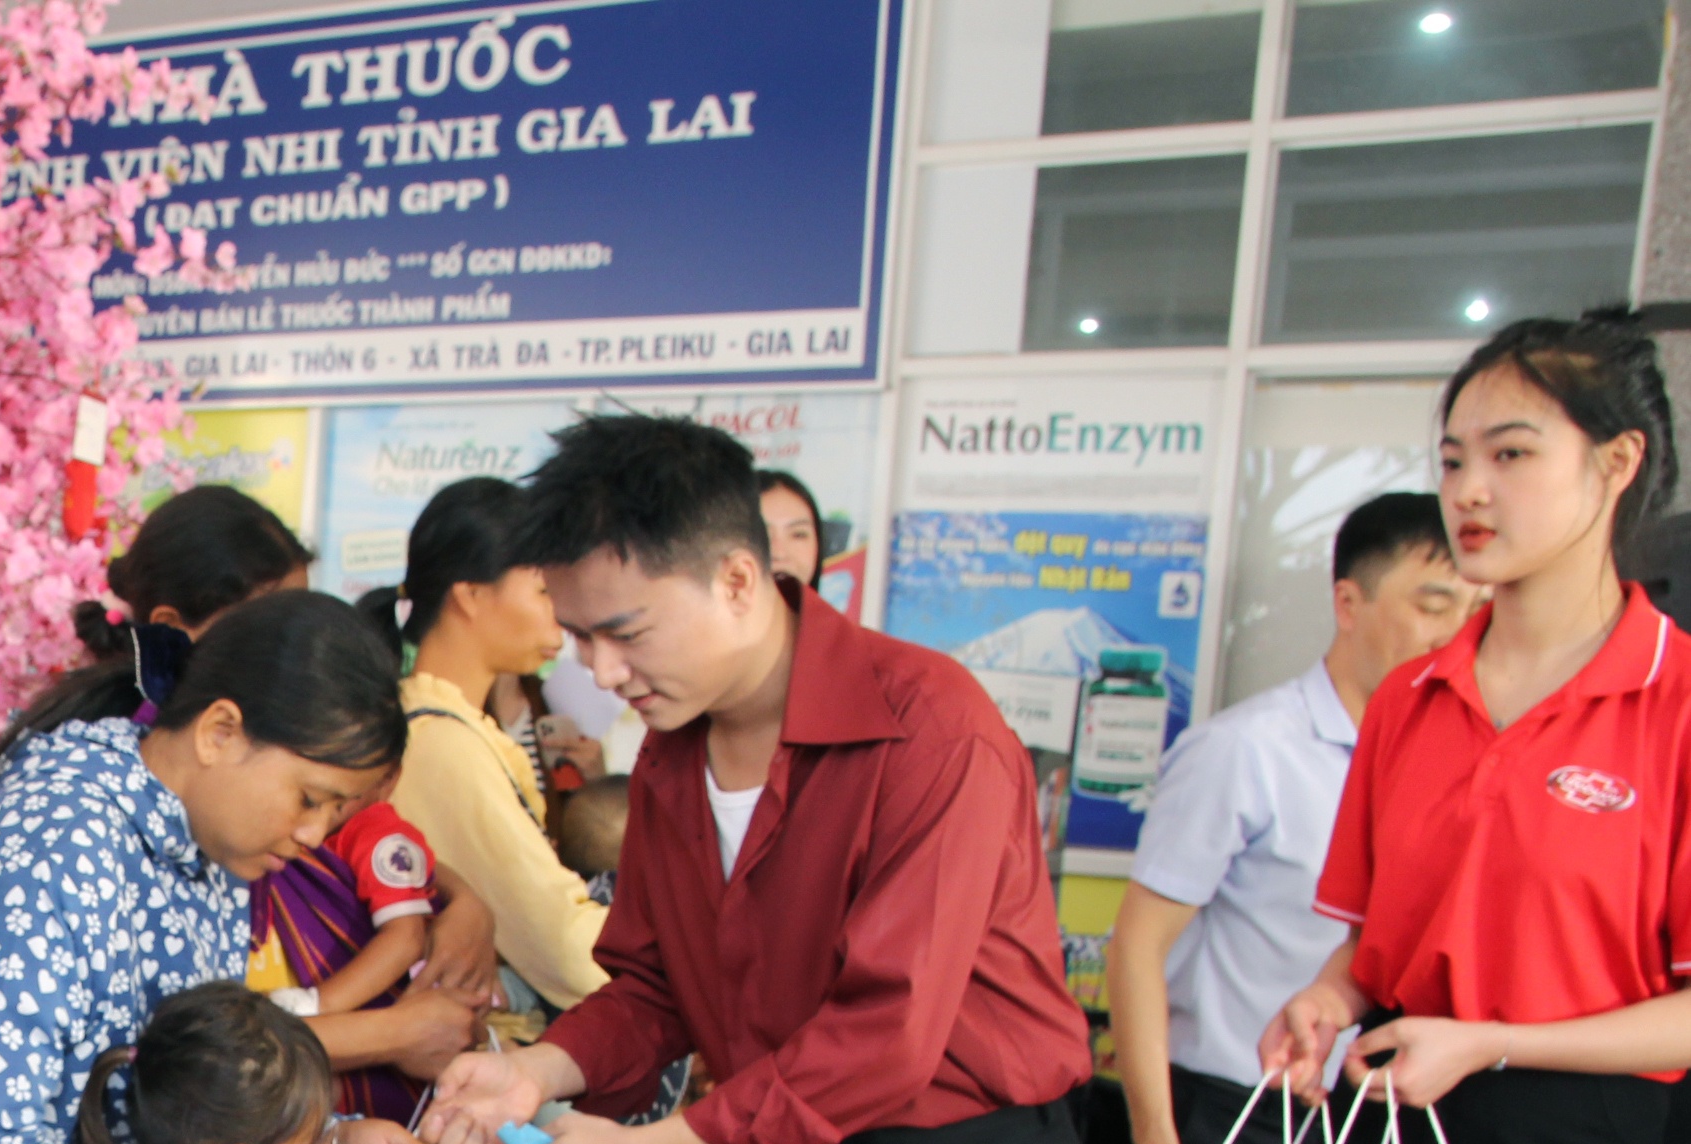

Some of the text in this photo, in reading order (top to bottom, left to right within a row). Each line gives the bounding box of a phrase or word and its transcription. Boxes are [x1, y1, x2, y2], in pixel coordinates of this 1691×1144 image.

[291, 12, 572, 109] THUỐC
[241, 129, 344, 178] NHI
[357, 107, 502, 168] TỈNH
[516, 104, 628, 154] GIA
[647, 91, 757, 144] LAI
[250, 172, 388, 226] CHUẨN
[230, 350, 268, 377] LAI
[290, 341, 353, 373] THÔN
[361, 346, 377, 371] 6
[747, 329, 793, 357] GIA
[809, 327, 852, 352] LAI
[921, 413, 1204, 467] NattoEnzym
